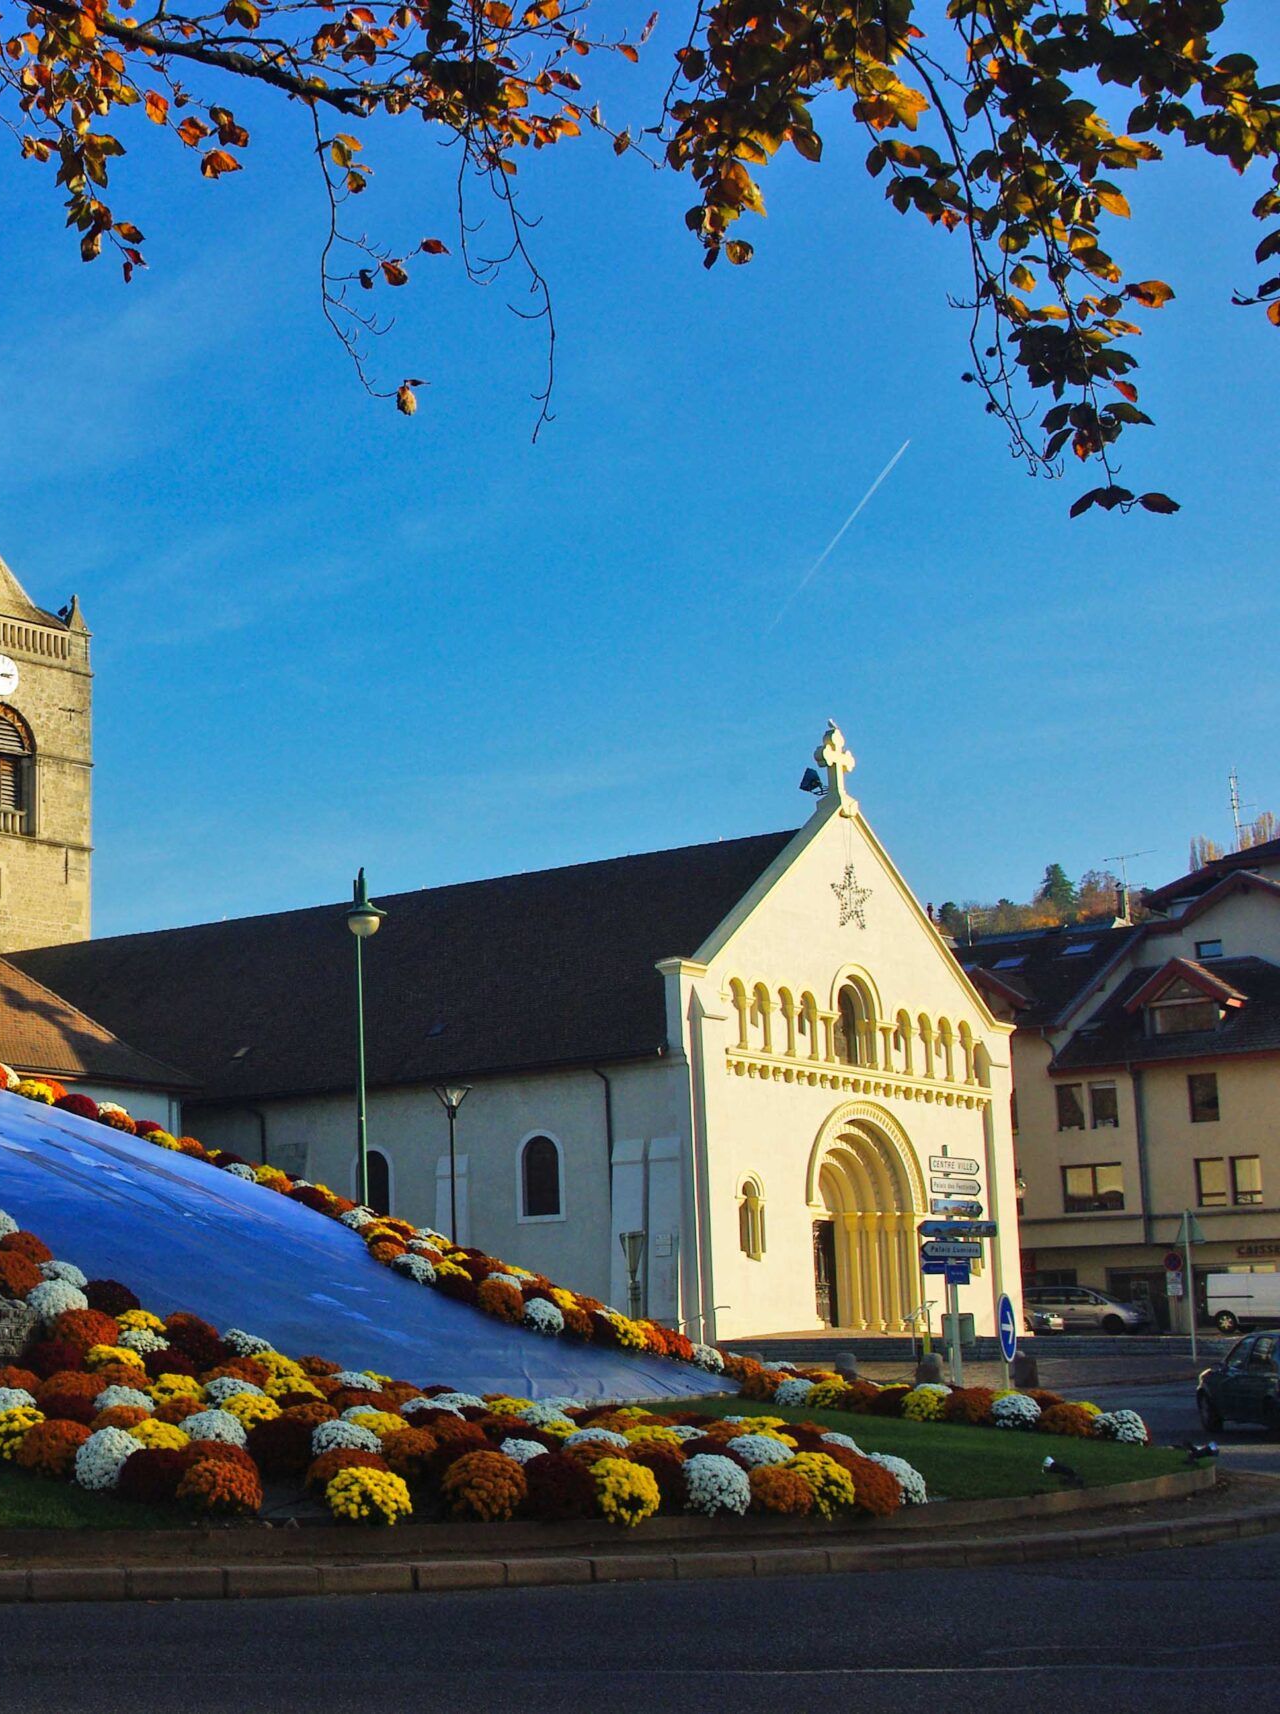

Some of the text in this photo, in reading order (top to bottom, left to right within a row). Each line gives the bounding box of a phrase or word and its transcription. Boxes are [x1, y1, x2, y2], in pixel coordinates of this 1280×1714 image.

[932, 1159, 974, 1171] CENTRE VILLE
[930, 1245, 950, 1254] Palais
